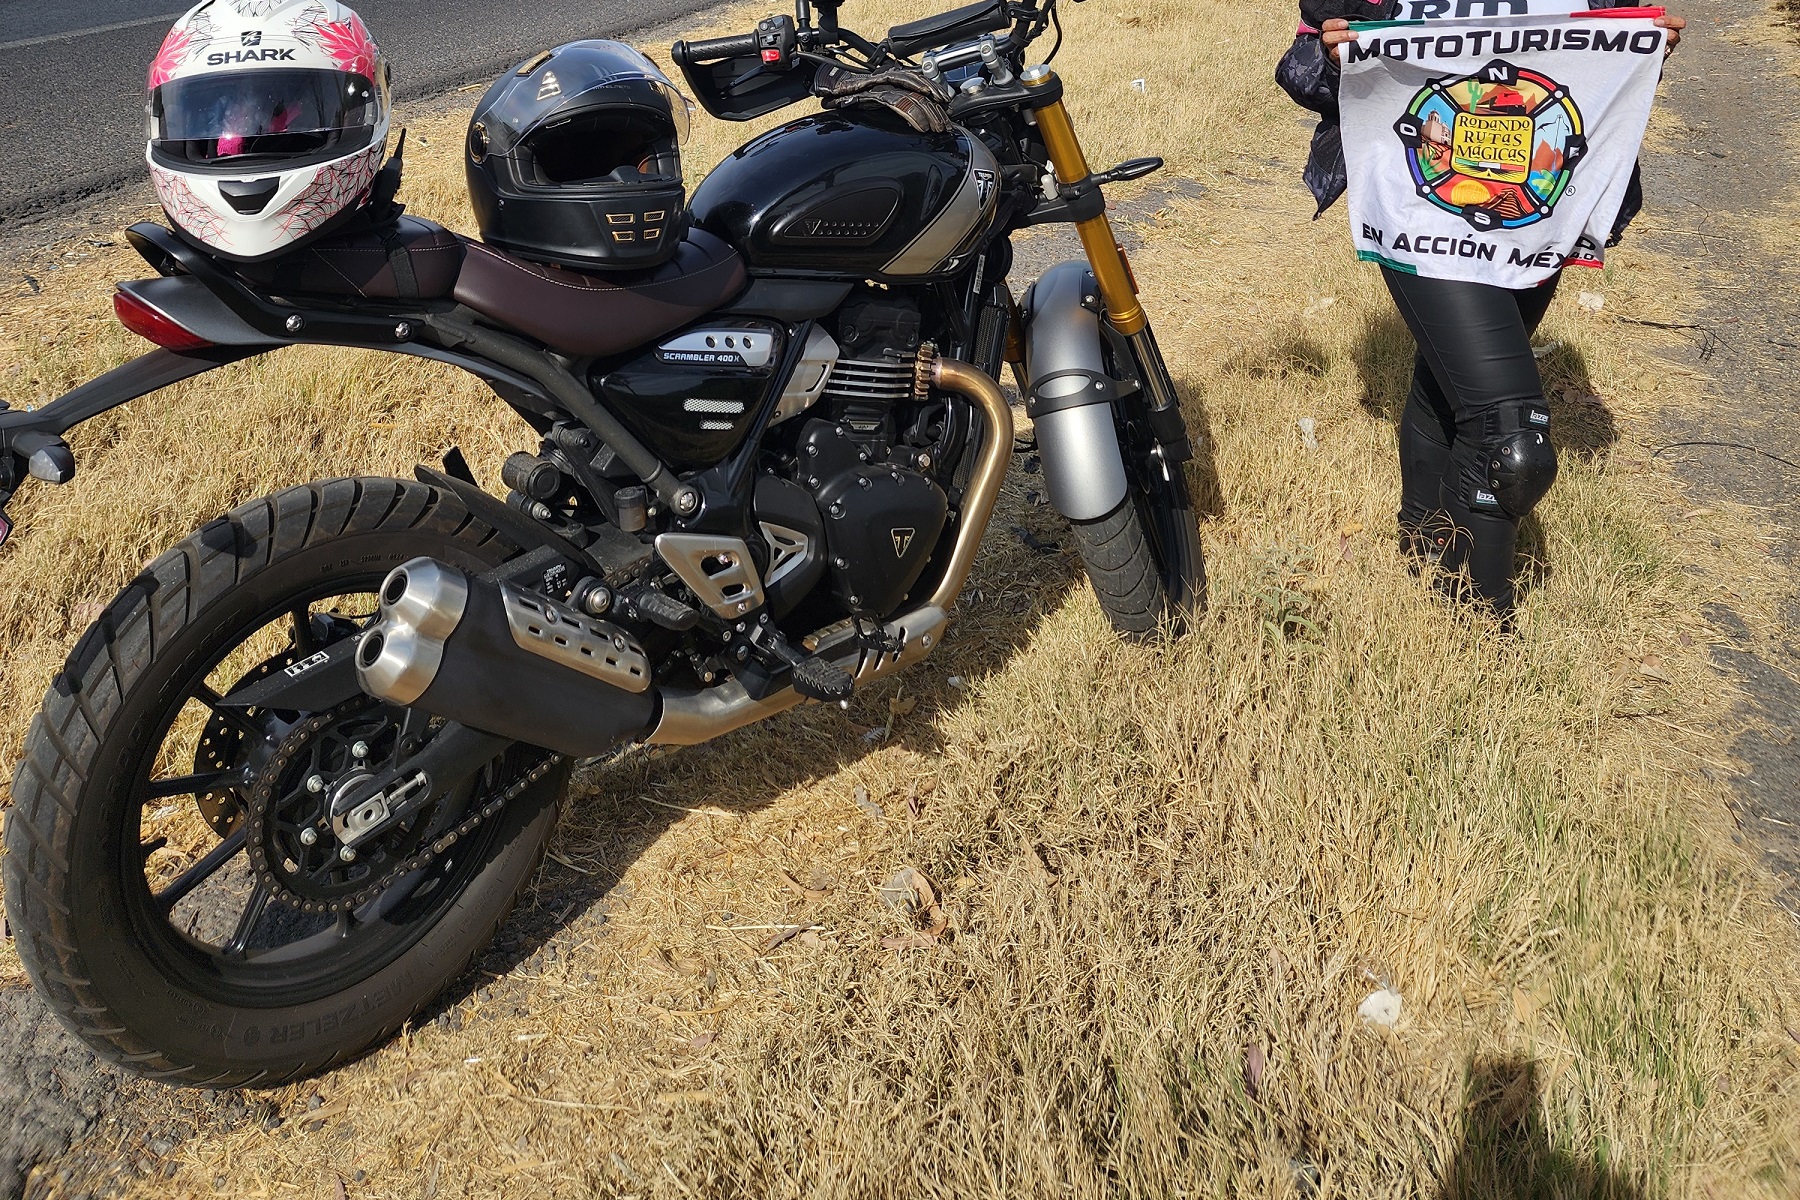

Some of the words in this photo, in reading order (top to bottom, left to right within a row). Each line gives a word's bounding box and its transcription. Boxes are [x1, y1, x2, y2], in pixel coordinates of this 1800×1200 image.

[1348, 28, 1662, 64] MOTOTURISMO
[207, 48, 297, 66] SHARK
[1488, 66, 1509, 81] N
[1474, 211, 1491, 225] S
[1362, 222, 1383, 246] EN
[1392, 233, 1497, 262] ACCIÓN
[663, 352, 715, 362] SCRAMBLER
